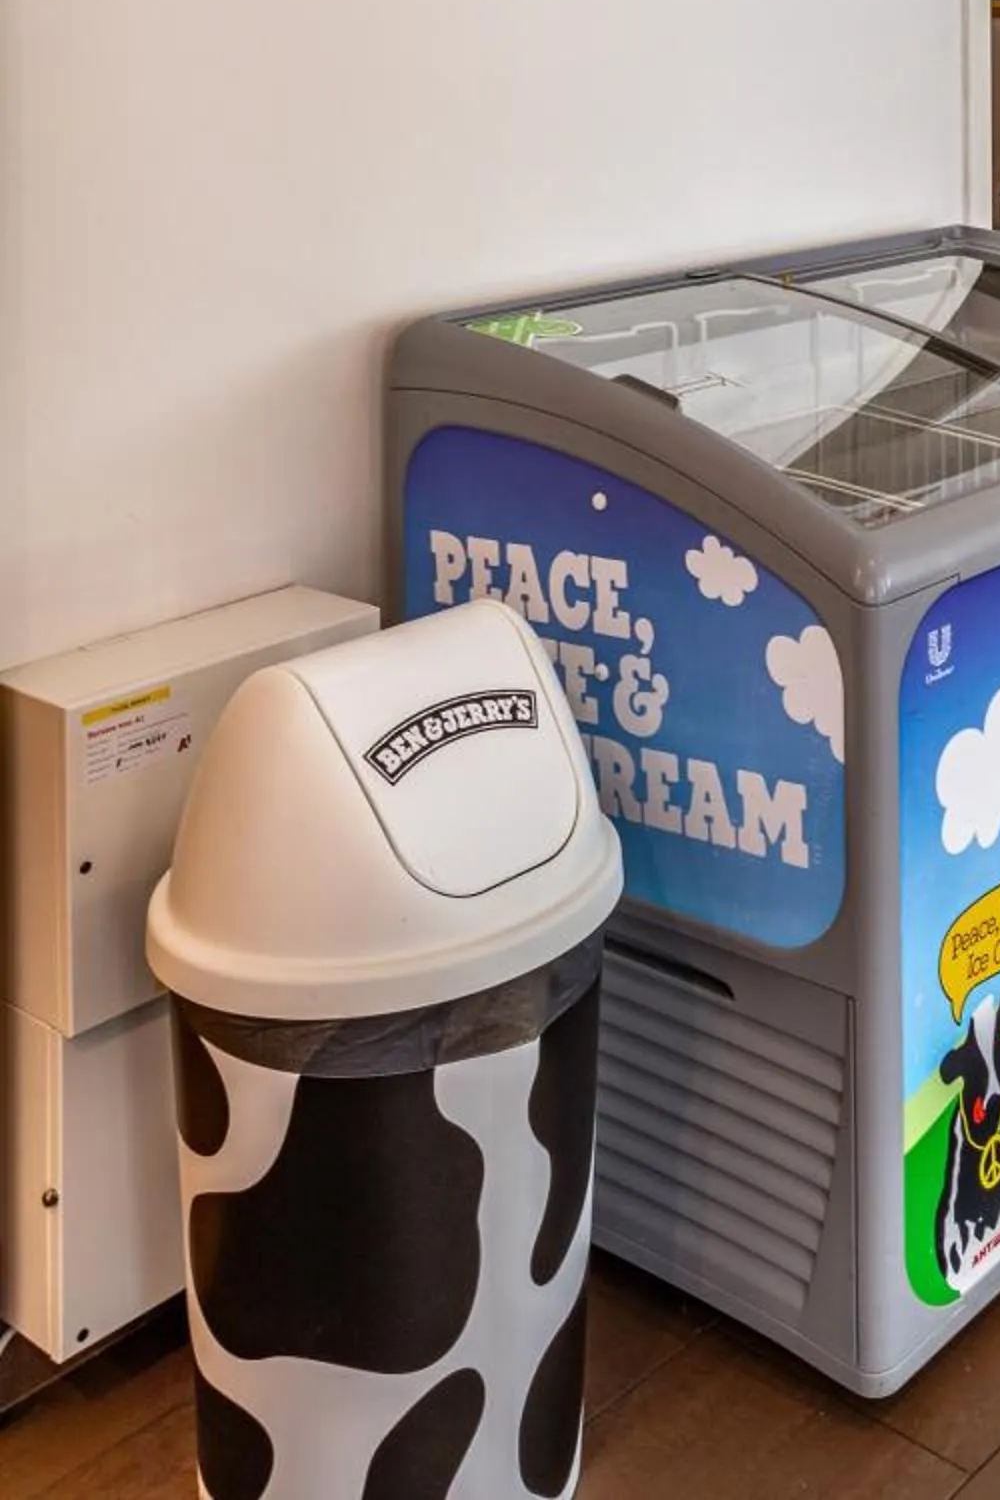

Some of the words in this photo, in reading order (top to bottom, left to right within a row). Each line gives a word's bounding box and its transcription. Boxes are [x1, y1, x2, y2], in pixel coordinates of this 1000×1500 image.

[430, 529, 654, 654] PEACE,
[613, 654, 669, 738] &
[580, 733, 809, 869] REAM
[951, 916, 999, 960] Peace,
[967, 953, 989, 979] Ice
